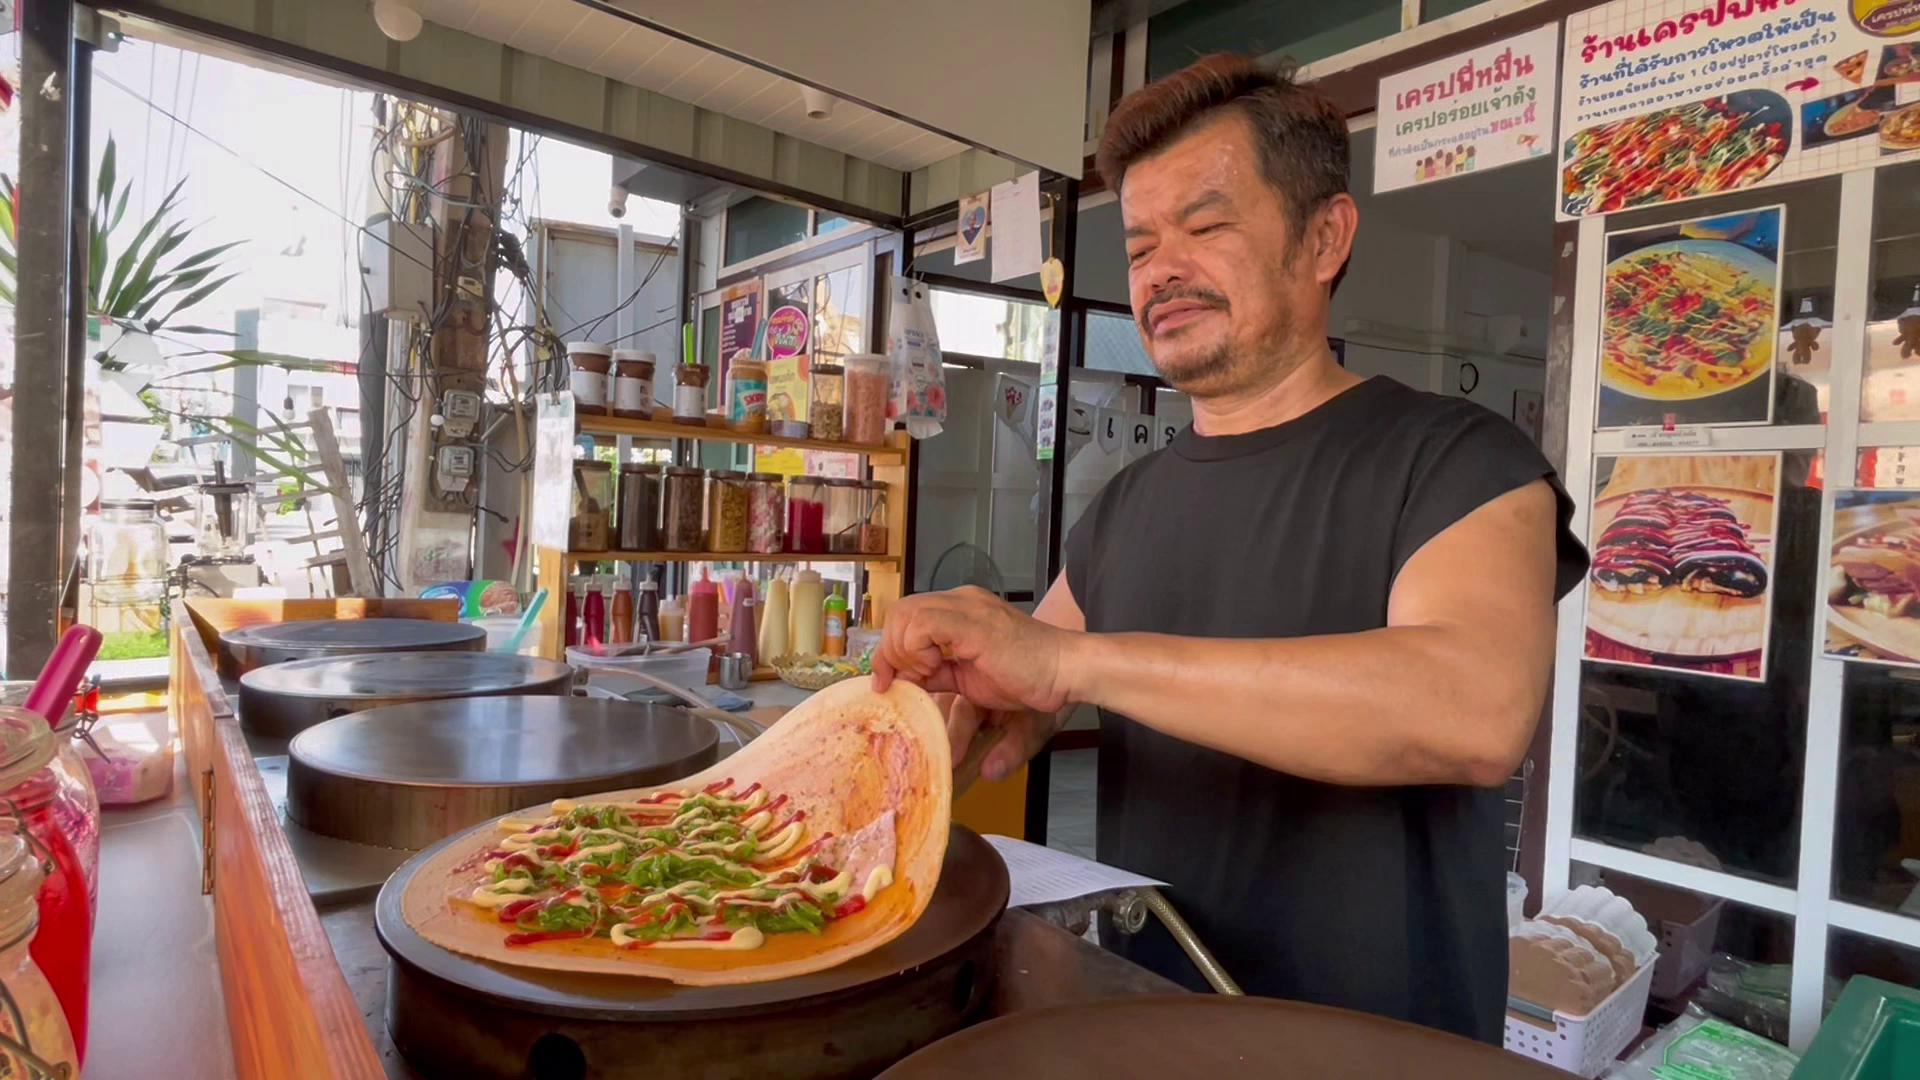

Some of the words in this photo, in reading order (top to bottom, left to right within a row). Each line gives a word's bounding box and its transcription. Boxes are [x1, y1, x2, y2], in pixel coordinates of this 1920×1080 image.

[1396, 85, 1536, 136] เครปอร่อยเจ้าดัง
